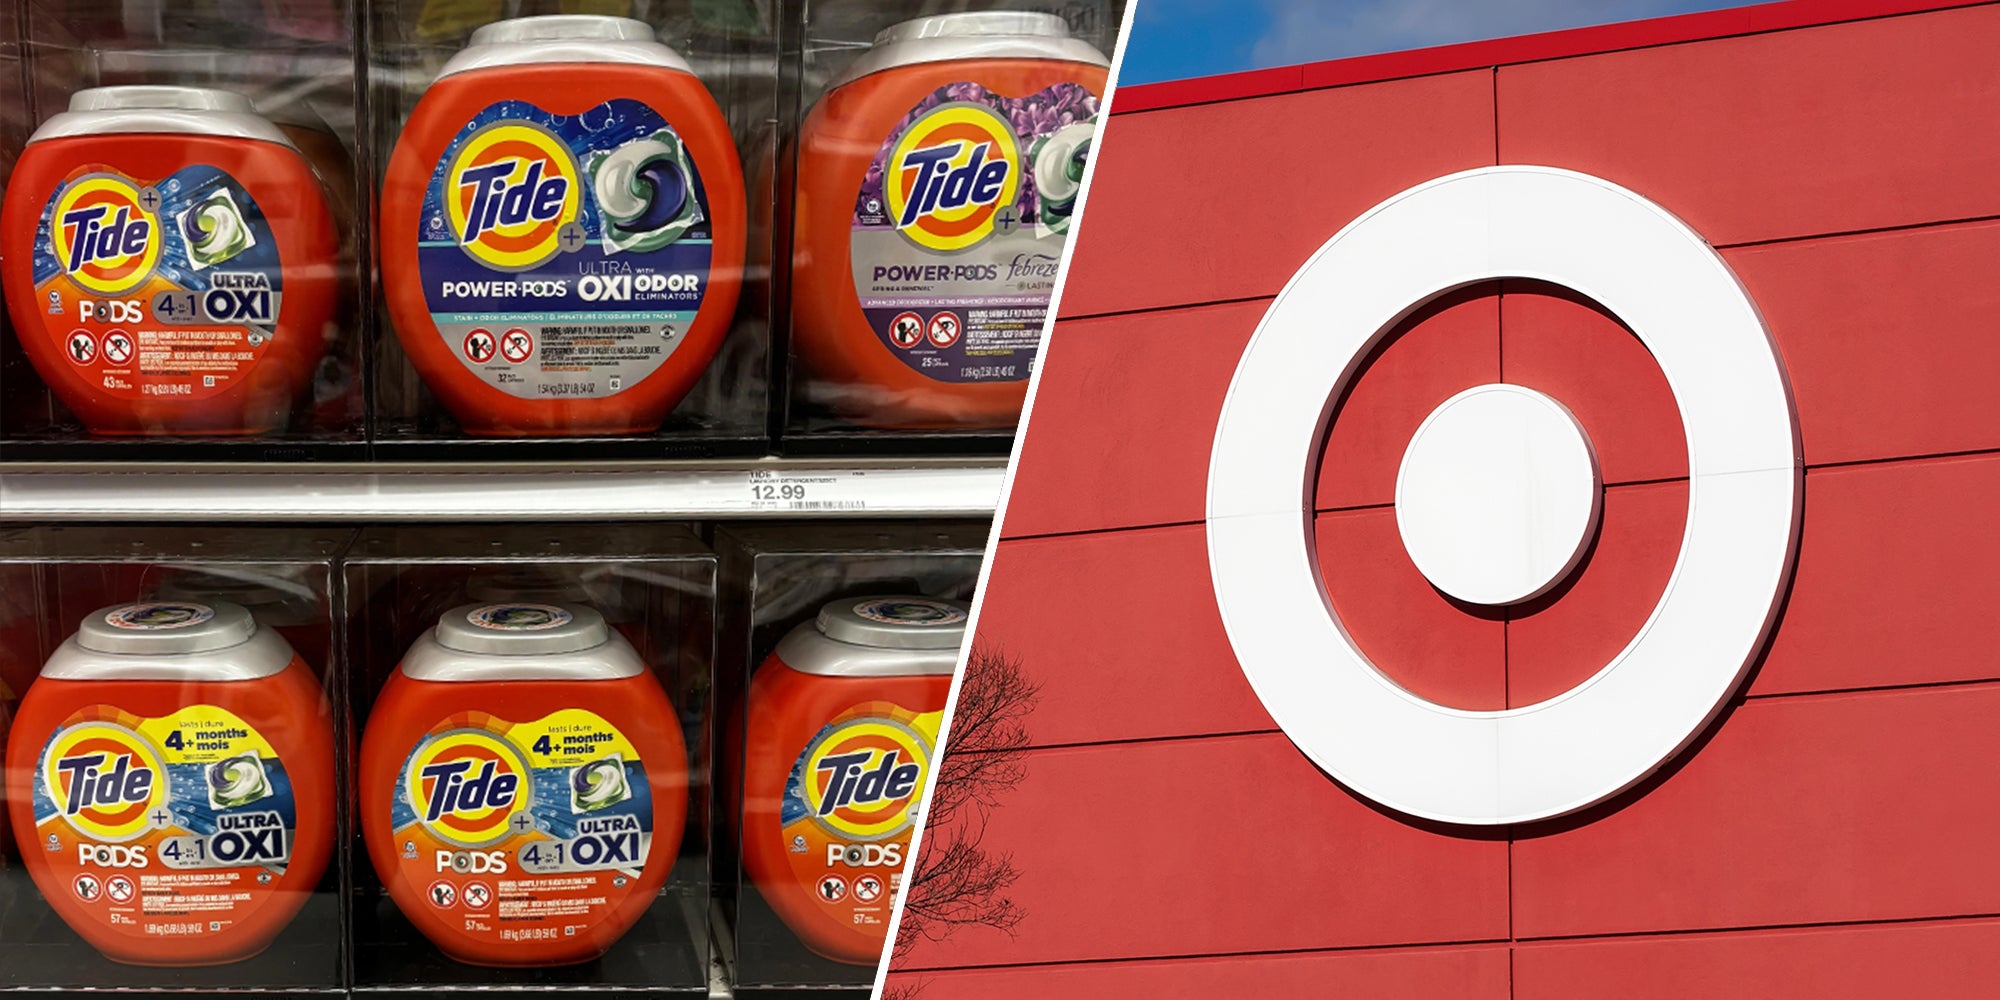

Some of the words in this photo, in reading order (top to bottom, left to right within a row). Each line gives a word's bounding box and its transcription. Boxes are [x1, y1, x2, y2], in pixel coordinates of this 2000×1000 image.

[897, 141, 1010, 230] Tide
[459, 158, 568, 246] Tide
[62, 206, 150, 274] Tide
[579, 261, 632, 275] ULTRA
[1006, 253, 1058, 281] febreze
[213, 274, 268, 289] ULTRA
[578, 276, 631, 301] OXI
[635, 275, 698, 292] ODOR
[205, 289, 271, 320] OXI
[635, 293, 699, 301] ELIMINATORS
[79, 300, 143, 323] PODS
[752, 485, 805, 500] 12.99
[196, 728, 248, 740] months
[197, 740, 229, 751] mois
[563, 732, 613, 744] months
[563, 743, 595, 755] mois
[58, 753, 153, 816] Tide
[421, 759, 518, 822] Tide
[815, 749, 920, 817] Tide
[220, 812, 281, 830] ULTRA
[580, 817, 638, 834] ULTRA
[78, 843, 148, 868] PODS
[212, 829, 283, 862] OXI
[571, 832, 639, 865] OXI
[827, 843, 902, 866] PODS
[436, 850, 507, 874] PODS
[110, 913, 120, 924] 57
[465, 920, 475, 930] 57
[853, 913, 865, 924] 57
